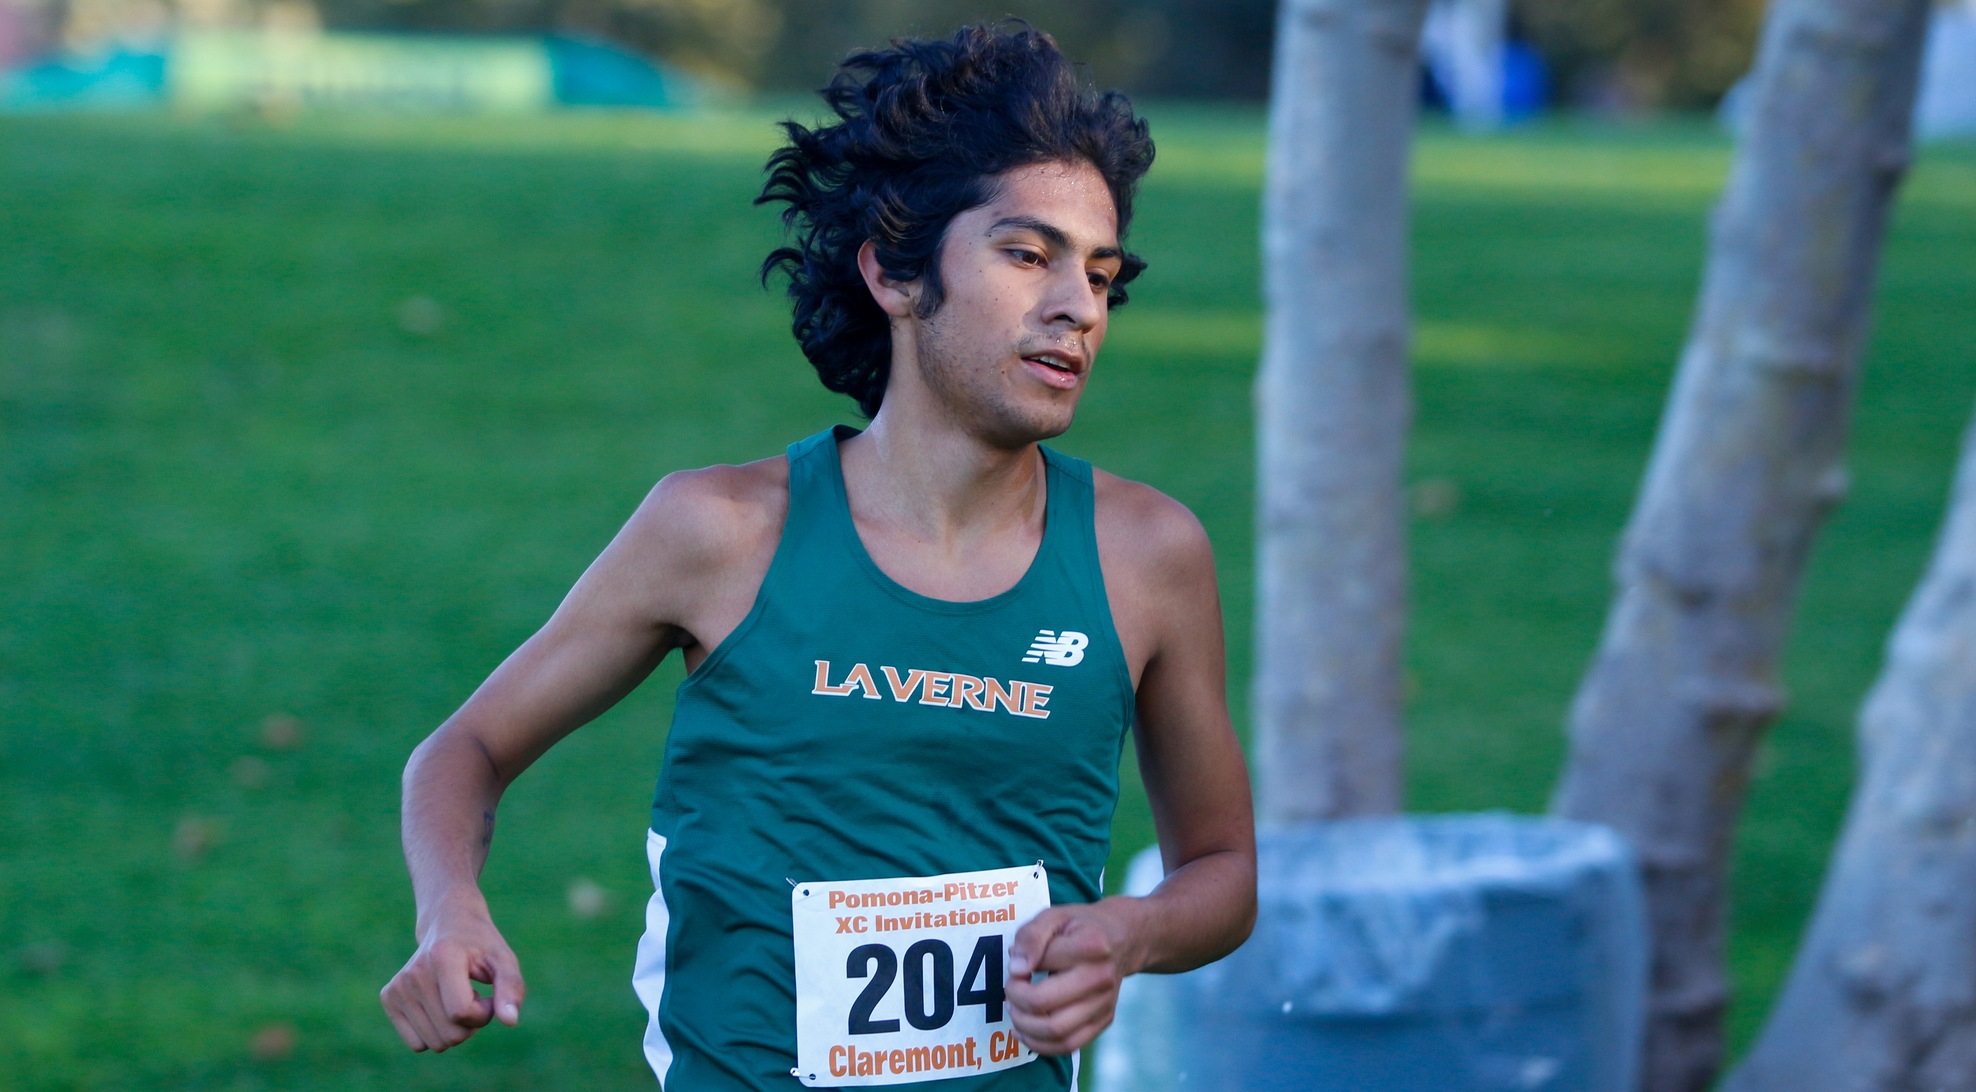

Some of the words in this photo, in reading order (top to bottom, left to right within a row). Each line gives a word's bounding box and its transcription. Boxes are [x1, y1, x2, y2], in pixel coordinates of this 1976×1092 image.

[1021, 629, 1089, 667] NB
[812, 660, 882, 699] LA
[880, 665, 1054, 719] VERNE
[829, 881, 1018, 908] Pomona-Pitzer
[836, 916, 868, 933] XC
[876, 904, 1015, 932] Invitational
[846, 934, 1006, 1035] 204
[829, 1037, 982, 1077] Claremont,
[989, 1030, 1019, 1062] CA
